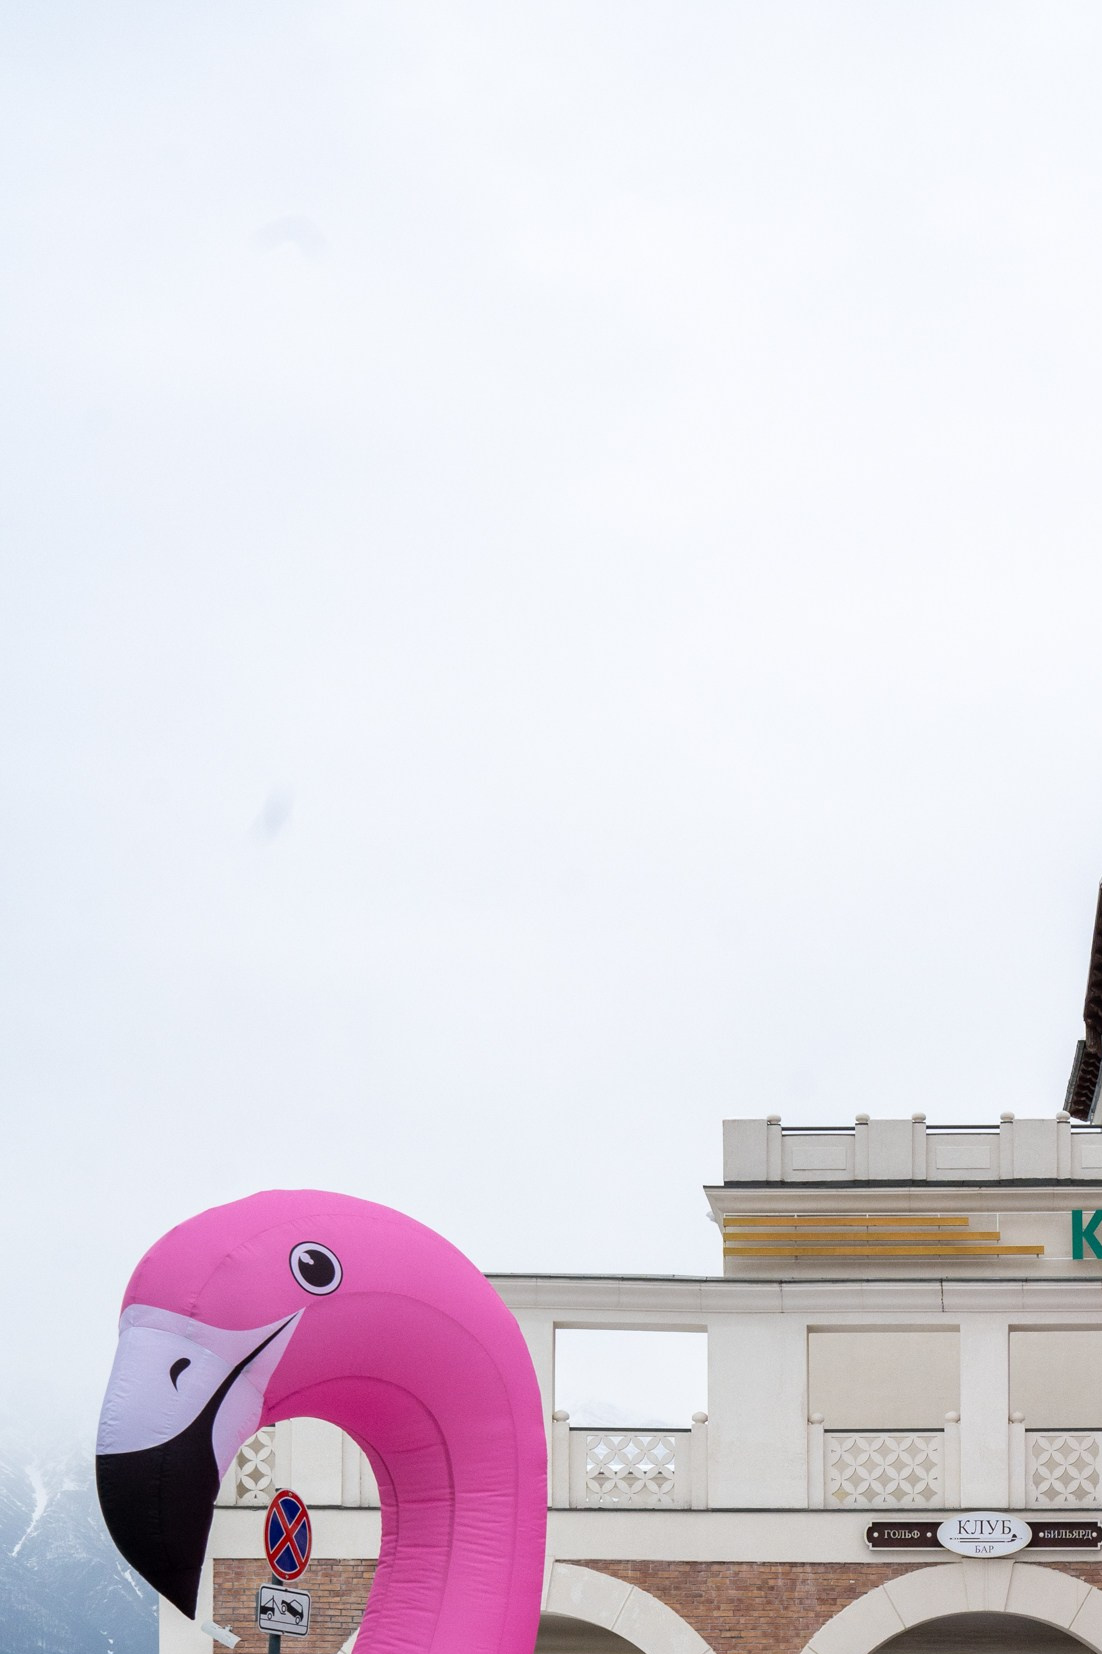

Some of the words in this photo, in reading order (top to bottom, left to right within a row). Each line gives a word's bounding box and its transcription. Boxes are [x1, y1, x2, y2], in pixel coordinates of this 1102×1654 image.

[957, 1519, 1012, 1536] КЛУБ
[884, 1529, 921, 1539] ГОЛЬФ
[1044, 1529, 1092, 1540] БИЛЬЯРД
[975, 1545, 994, 1553] БАР
